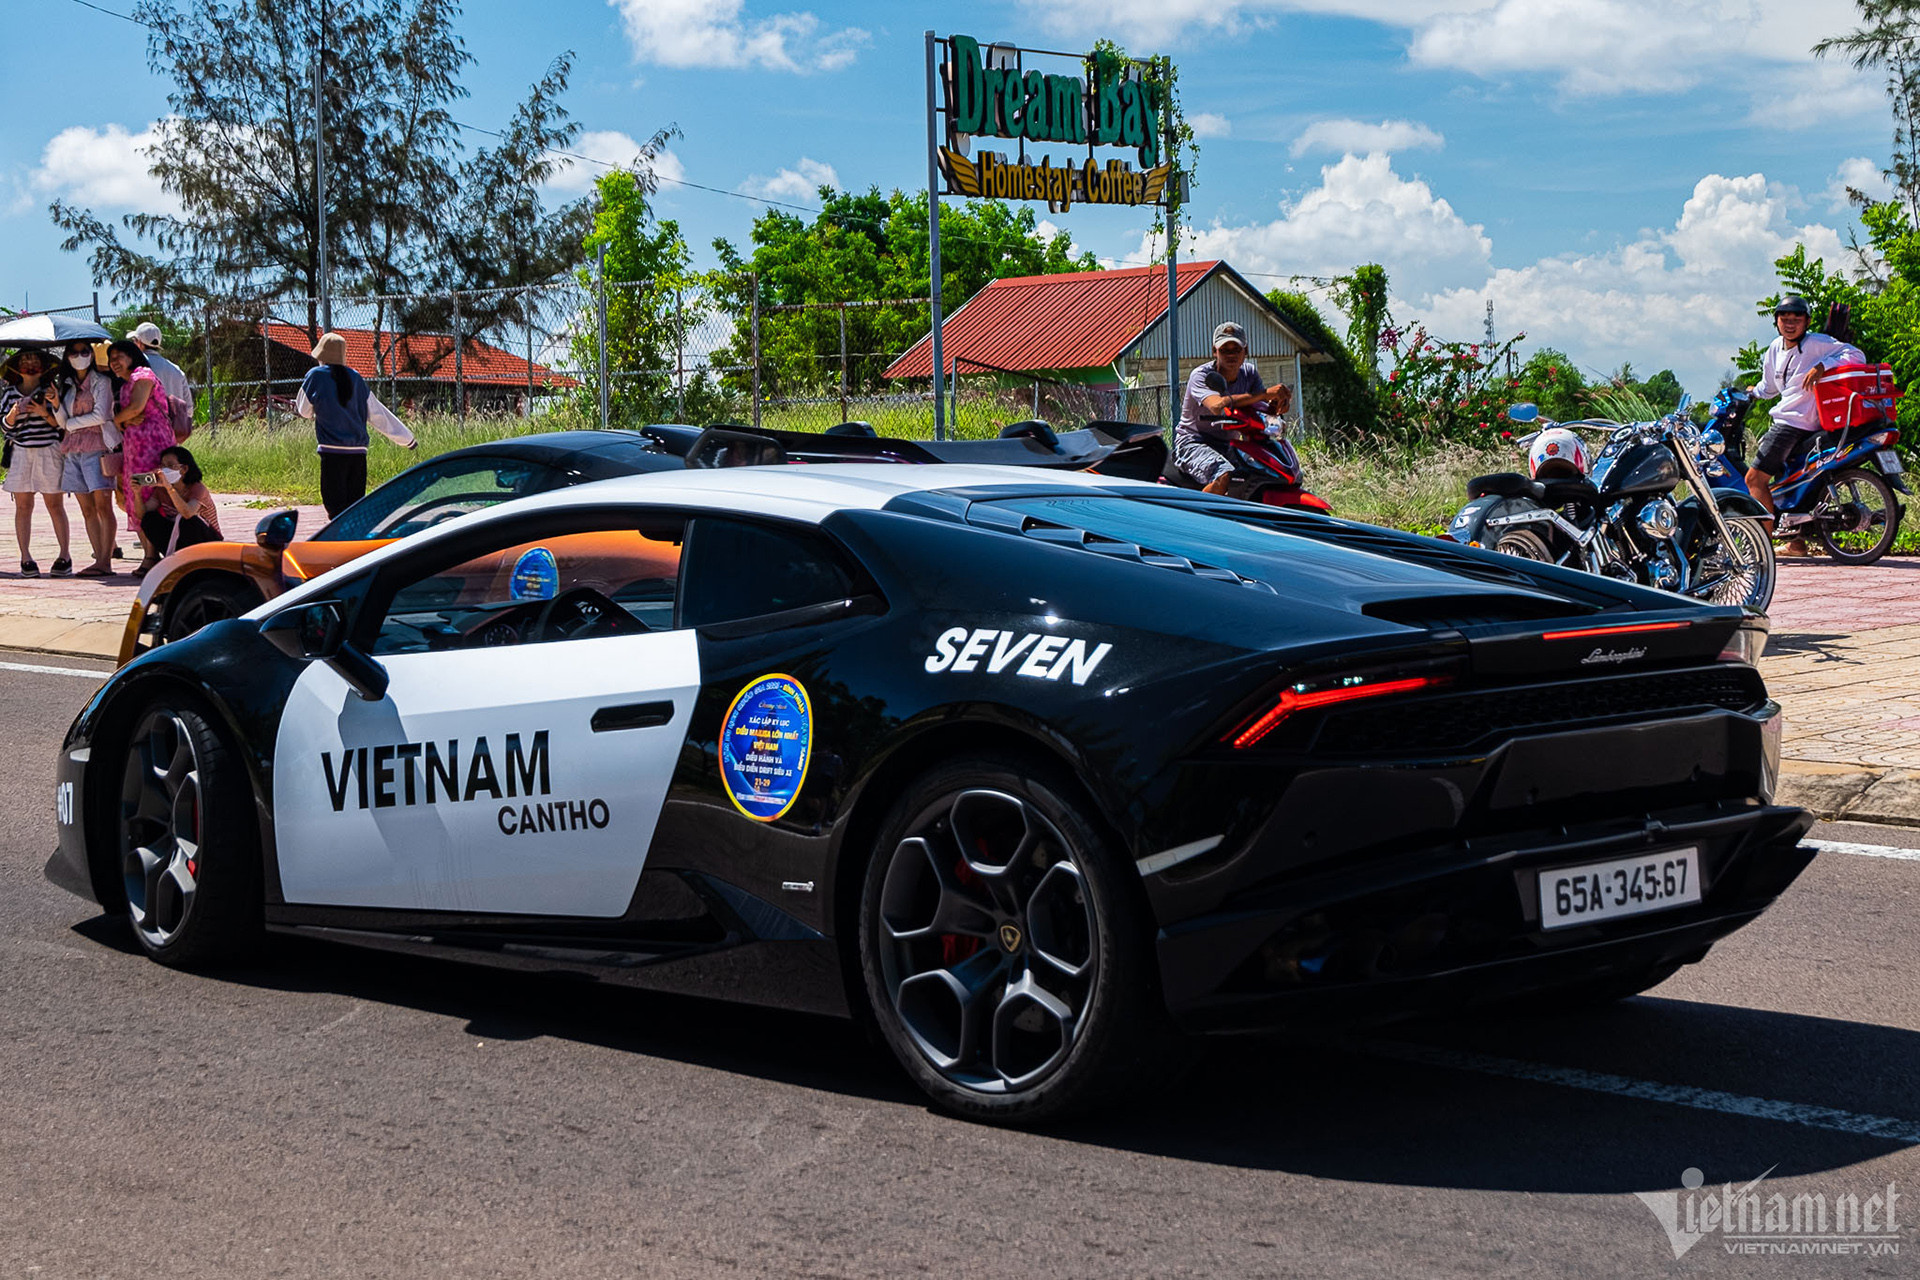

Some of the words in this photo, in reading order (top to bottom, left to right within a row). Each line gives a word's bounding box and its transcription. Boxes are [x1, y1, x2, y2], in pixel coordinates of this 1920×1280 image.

[949, 34, 1086, 143] Dream
[1089, 51, 1159, 168] Bay
[978, 151, 1074, 212] Homestay
[1083, 157, 1144, 204] Coffee
[924, 626, 1113, 686] SEVEN
[320, 729, 551, 812] VIETNAM
[497, 798, 610, 836] CANTHO
